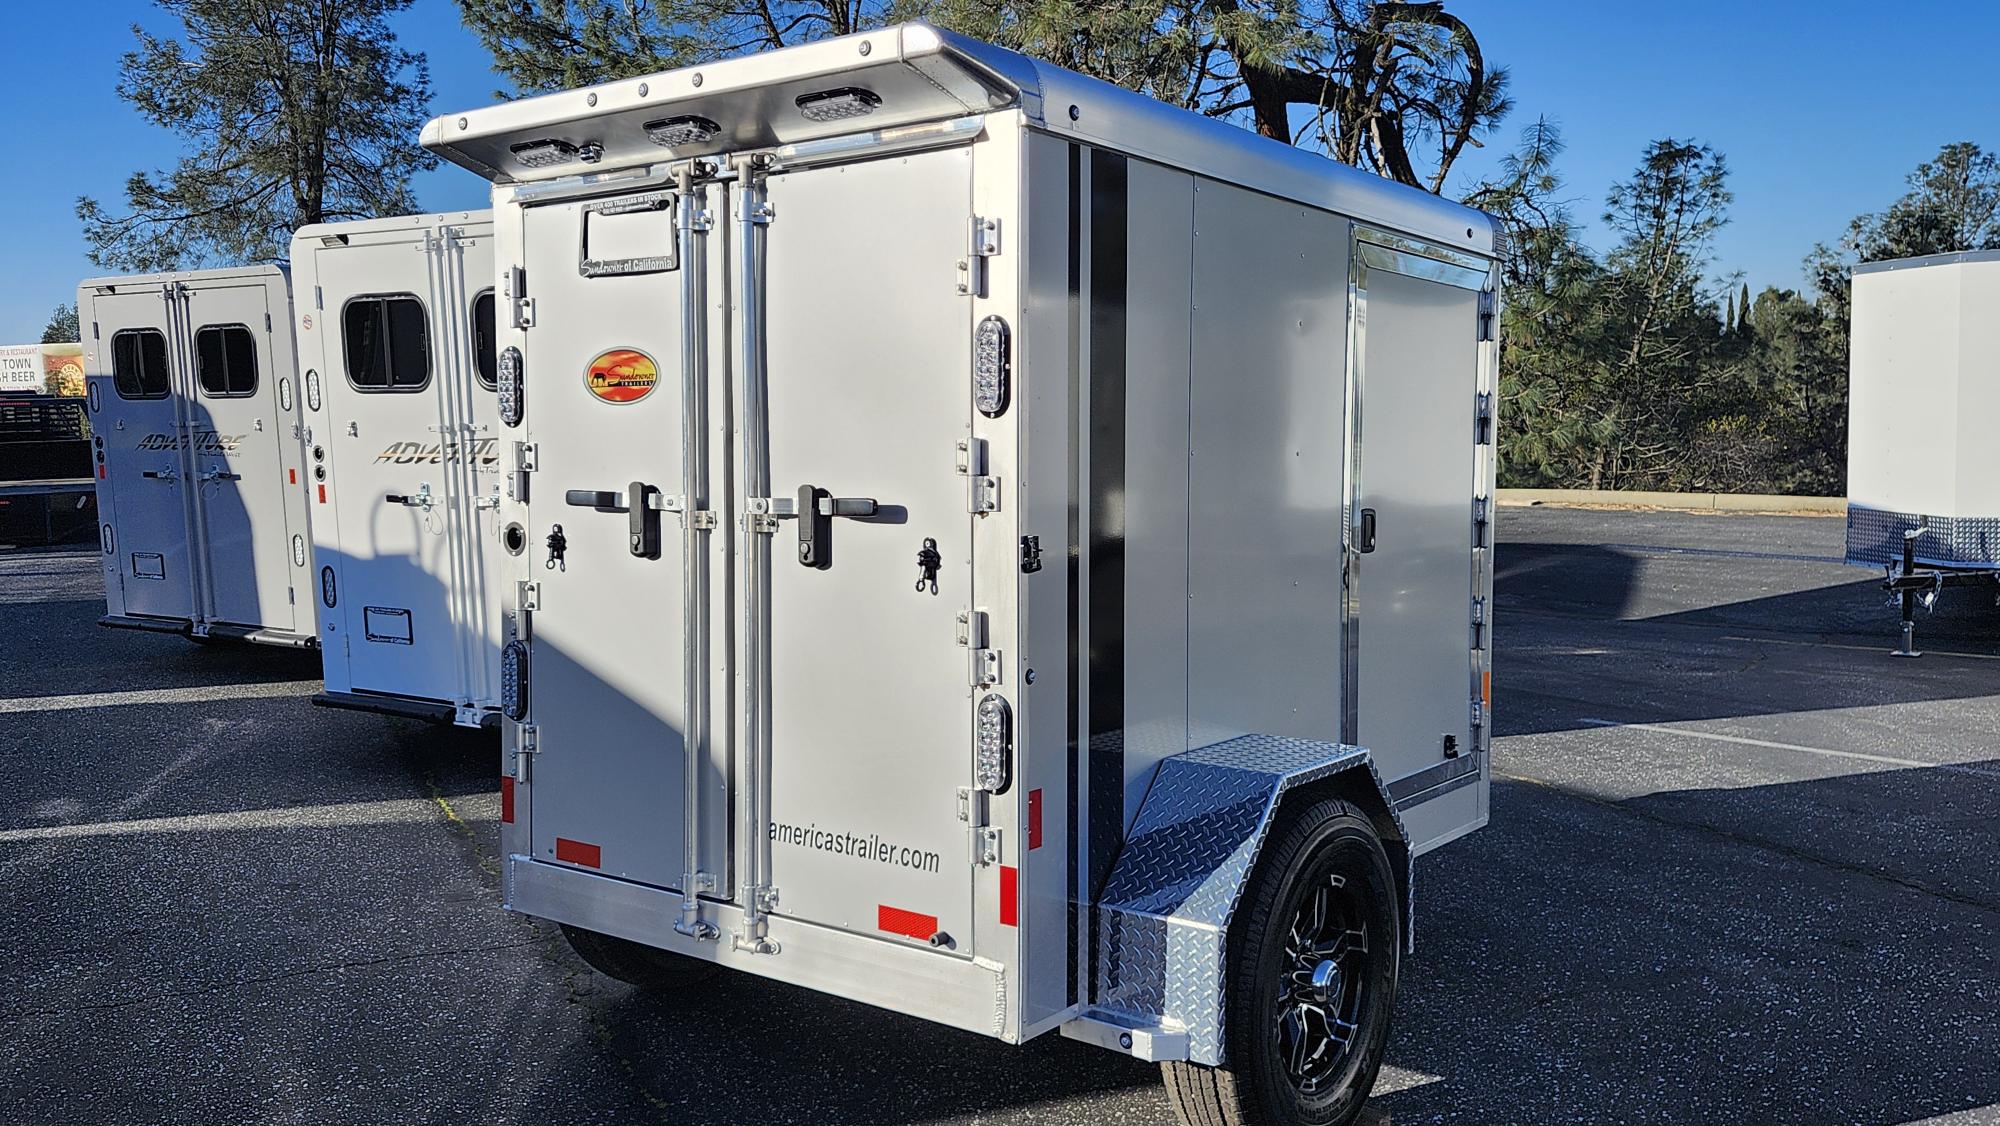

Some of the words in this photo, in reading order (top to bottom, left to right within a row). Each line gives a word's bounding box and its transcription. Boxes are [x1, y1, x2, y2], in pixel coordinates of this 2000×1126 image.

[624, 260, 632, 270] of
[633, 258, 672, 270] California
[3, 358, 31, 369] TOWN
[11, 371, 36, 382] BEER
[135, 431, 247, 451] ADVENTURE
[373, 437, 499, 465] ADVENTU
[769, 822, 940, 873] americastrailer.com
